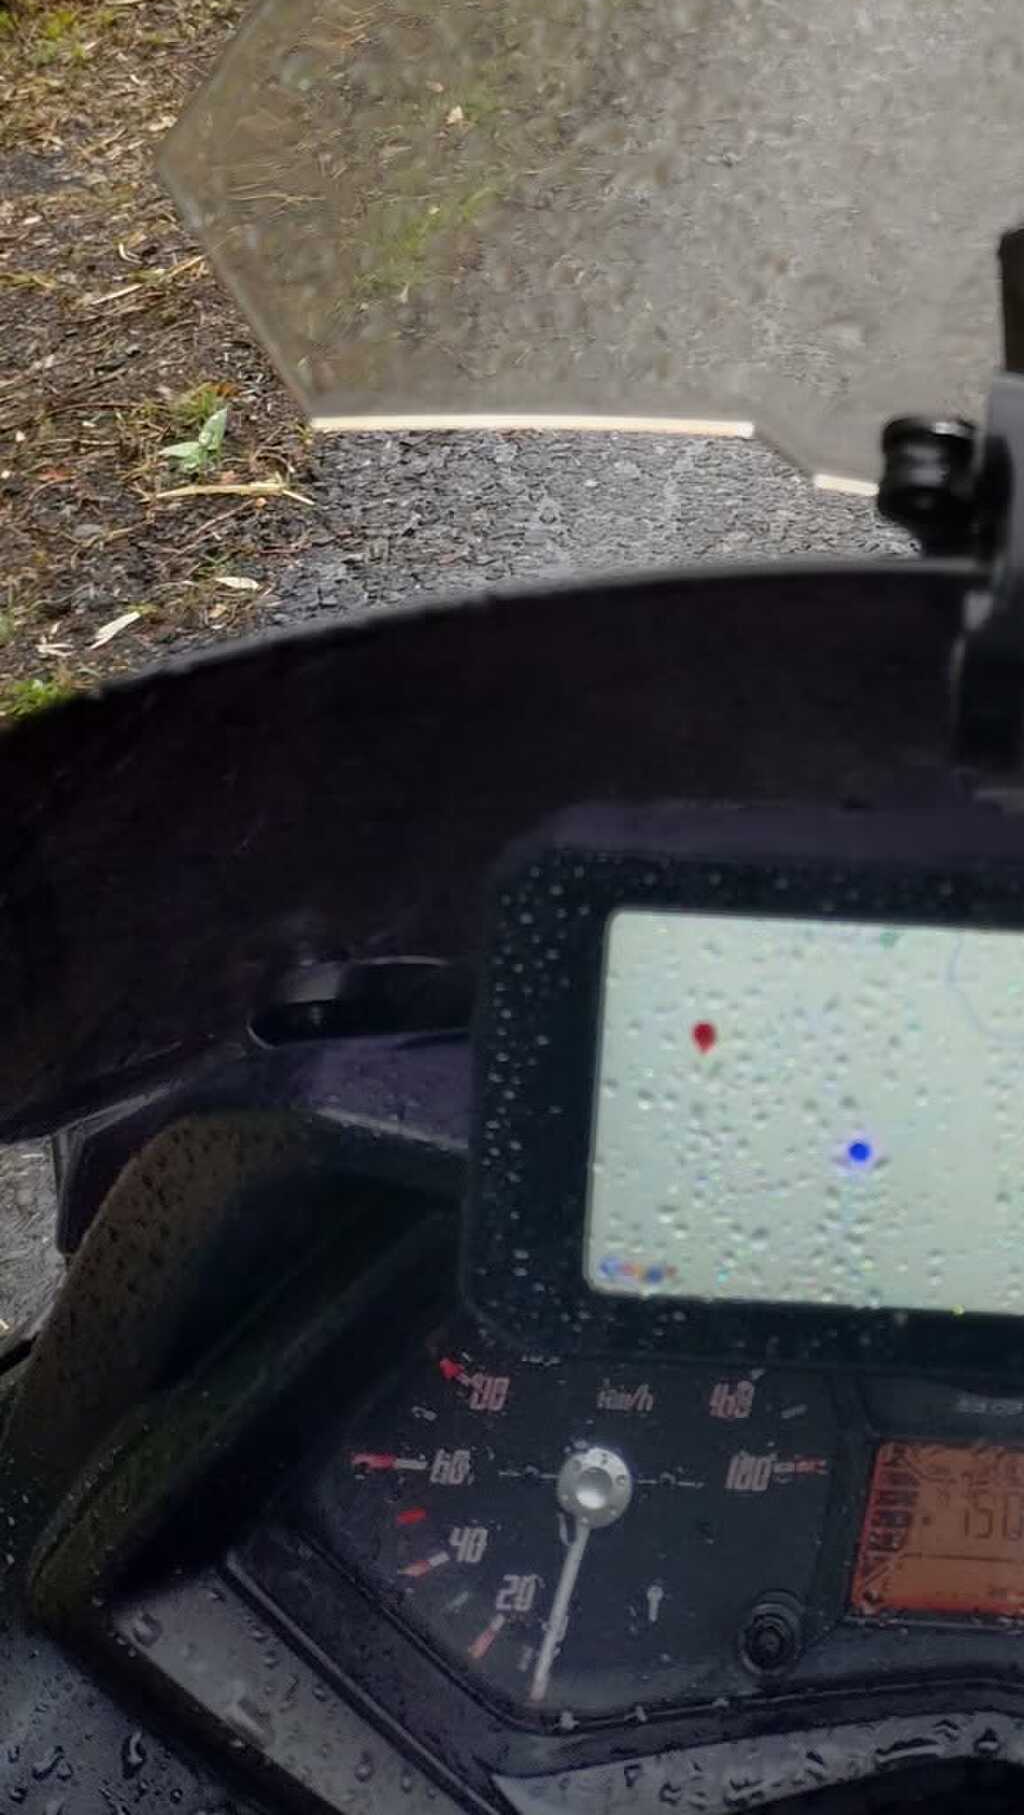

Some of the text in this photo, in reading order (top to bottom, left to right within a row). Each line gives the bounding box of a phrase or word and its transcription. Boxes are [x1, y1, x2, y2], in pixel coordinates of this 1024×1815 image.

[430, 1449, 471, 1485] 60
[449, 1526, 488, 1563] 40
[495, 1575, 536, 1612] 20
